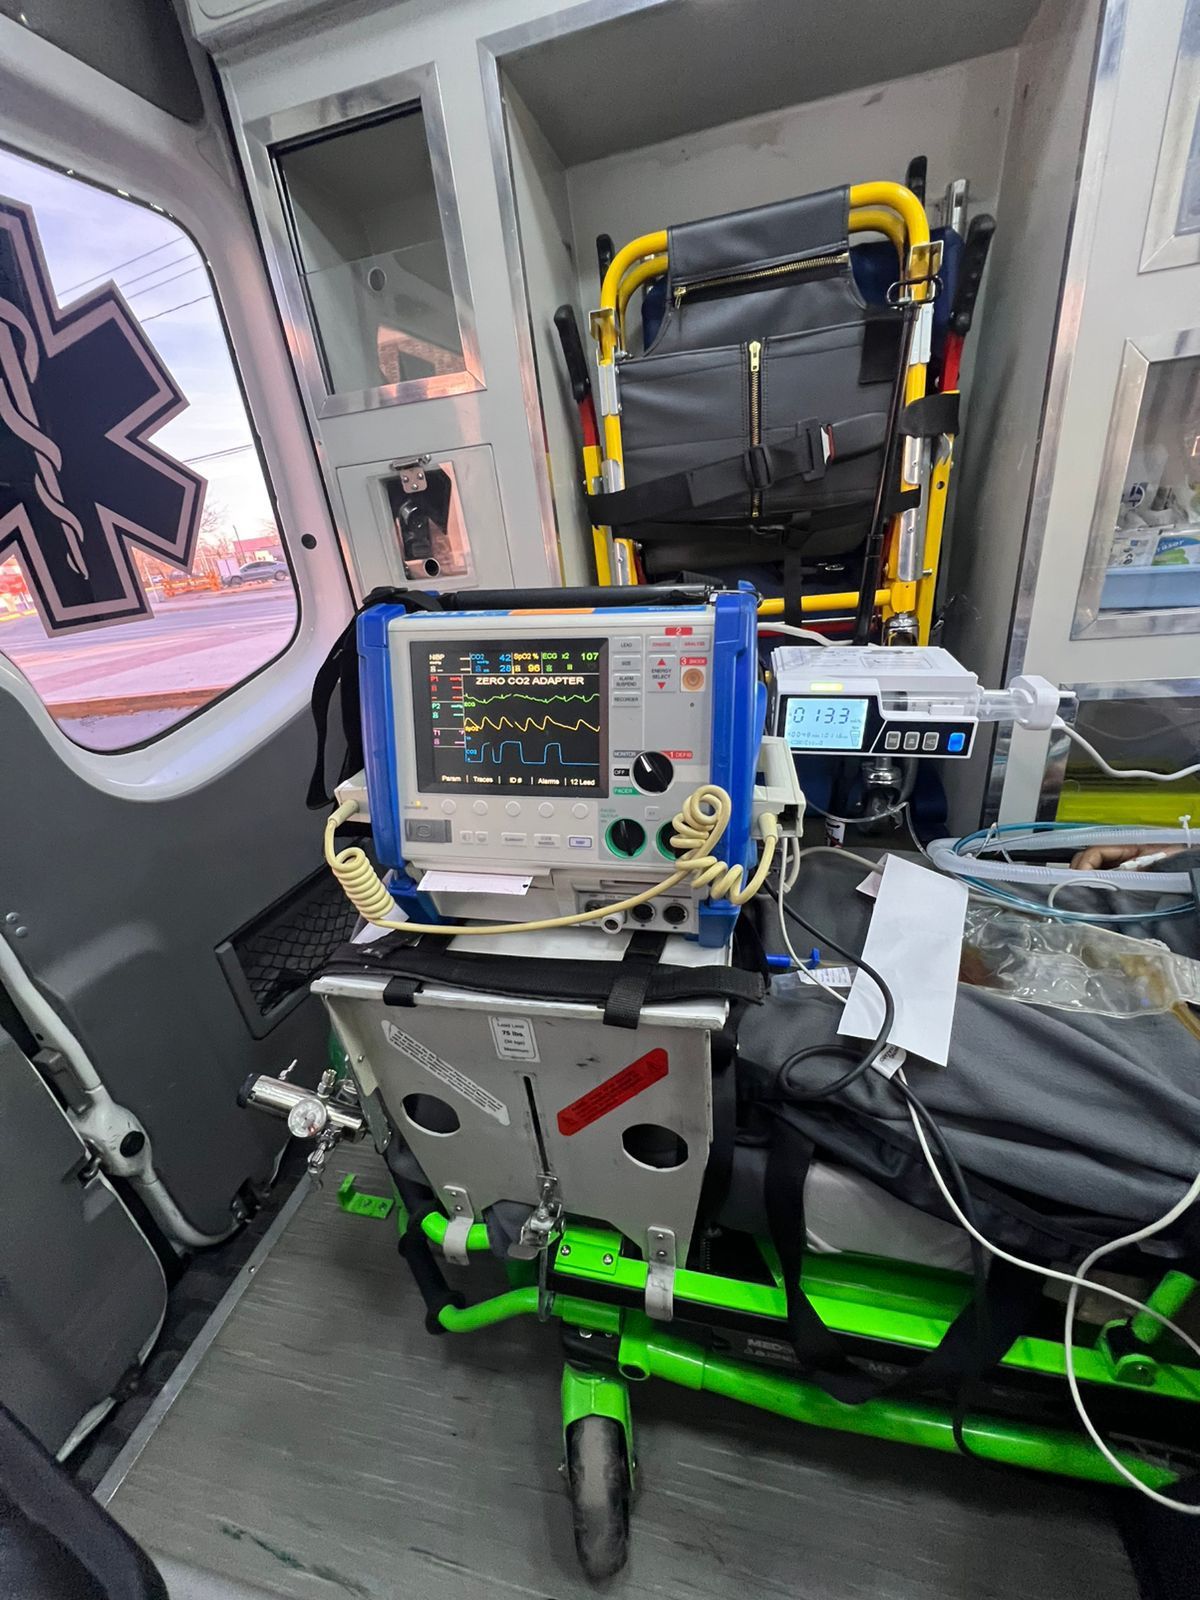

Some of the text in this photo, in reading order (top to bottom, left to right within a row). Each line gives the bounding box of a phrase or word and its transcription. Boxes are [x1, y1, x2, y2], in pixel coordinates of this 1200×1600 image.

[499, 654, 512, 662] 42
[514, 653, 530, 661] SpO2
[581, 652, 599, 661] 107
[475, 676, 584, 685] ZERO CO2 ADAPTER
